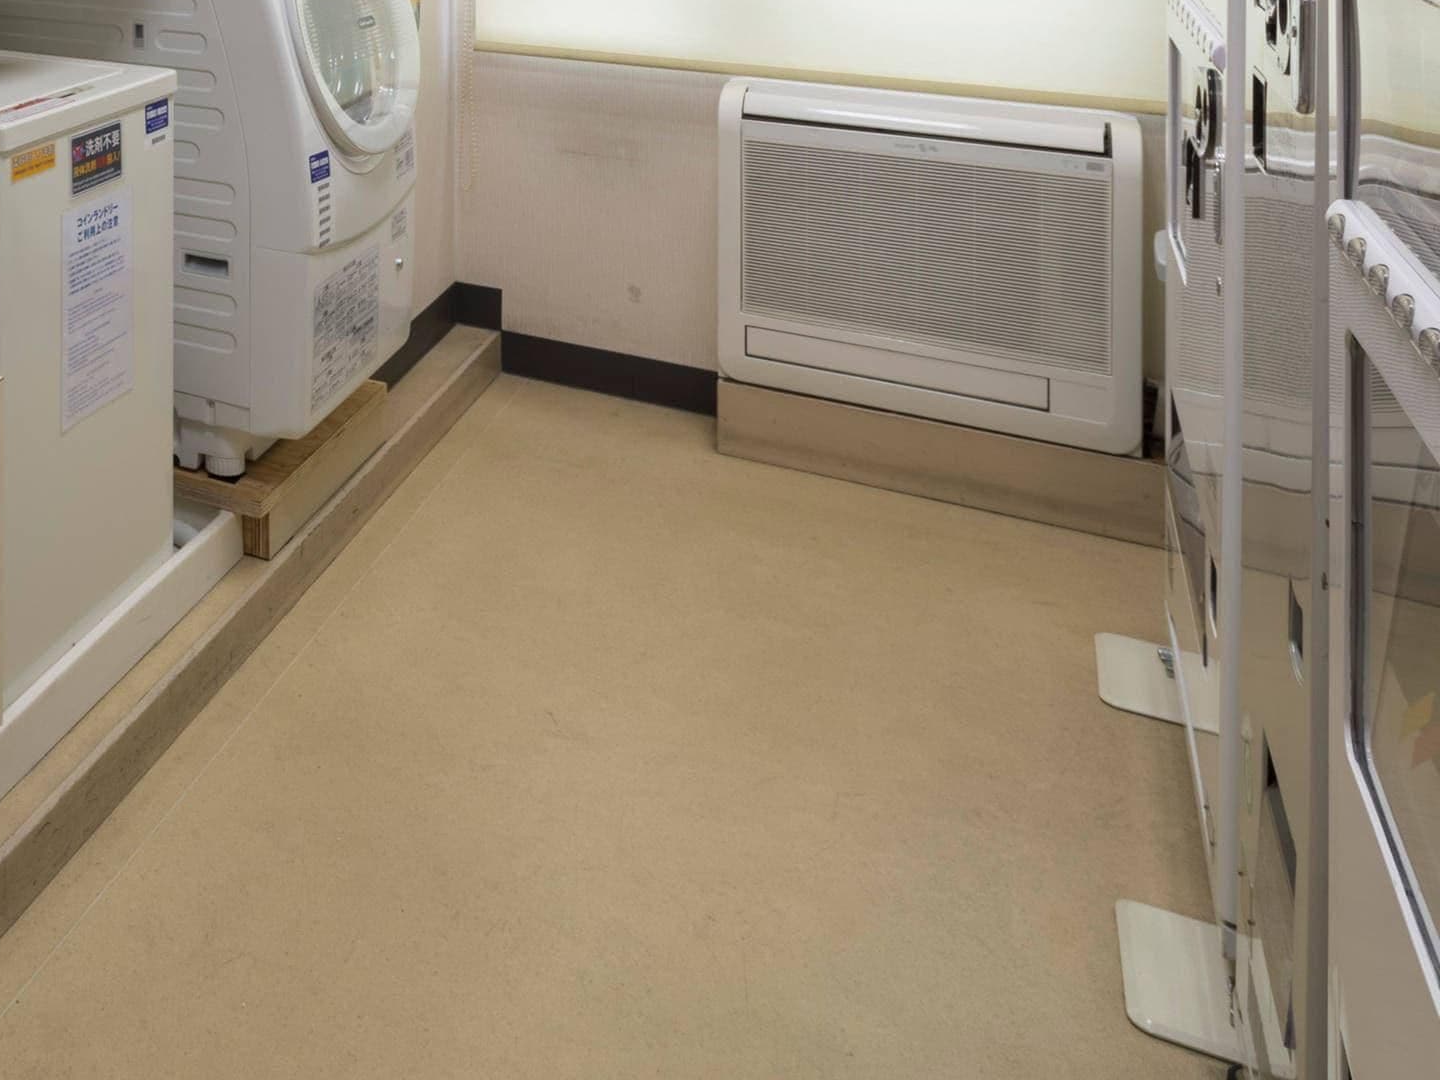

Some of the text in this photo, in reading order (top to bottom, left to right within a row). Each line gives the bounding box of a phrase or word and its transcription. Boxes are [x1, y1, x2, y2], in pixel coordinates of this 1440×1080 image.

[85, 129, 120, 157] 洗剤不要
[77, 203, 119, 228] コインランドリー
